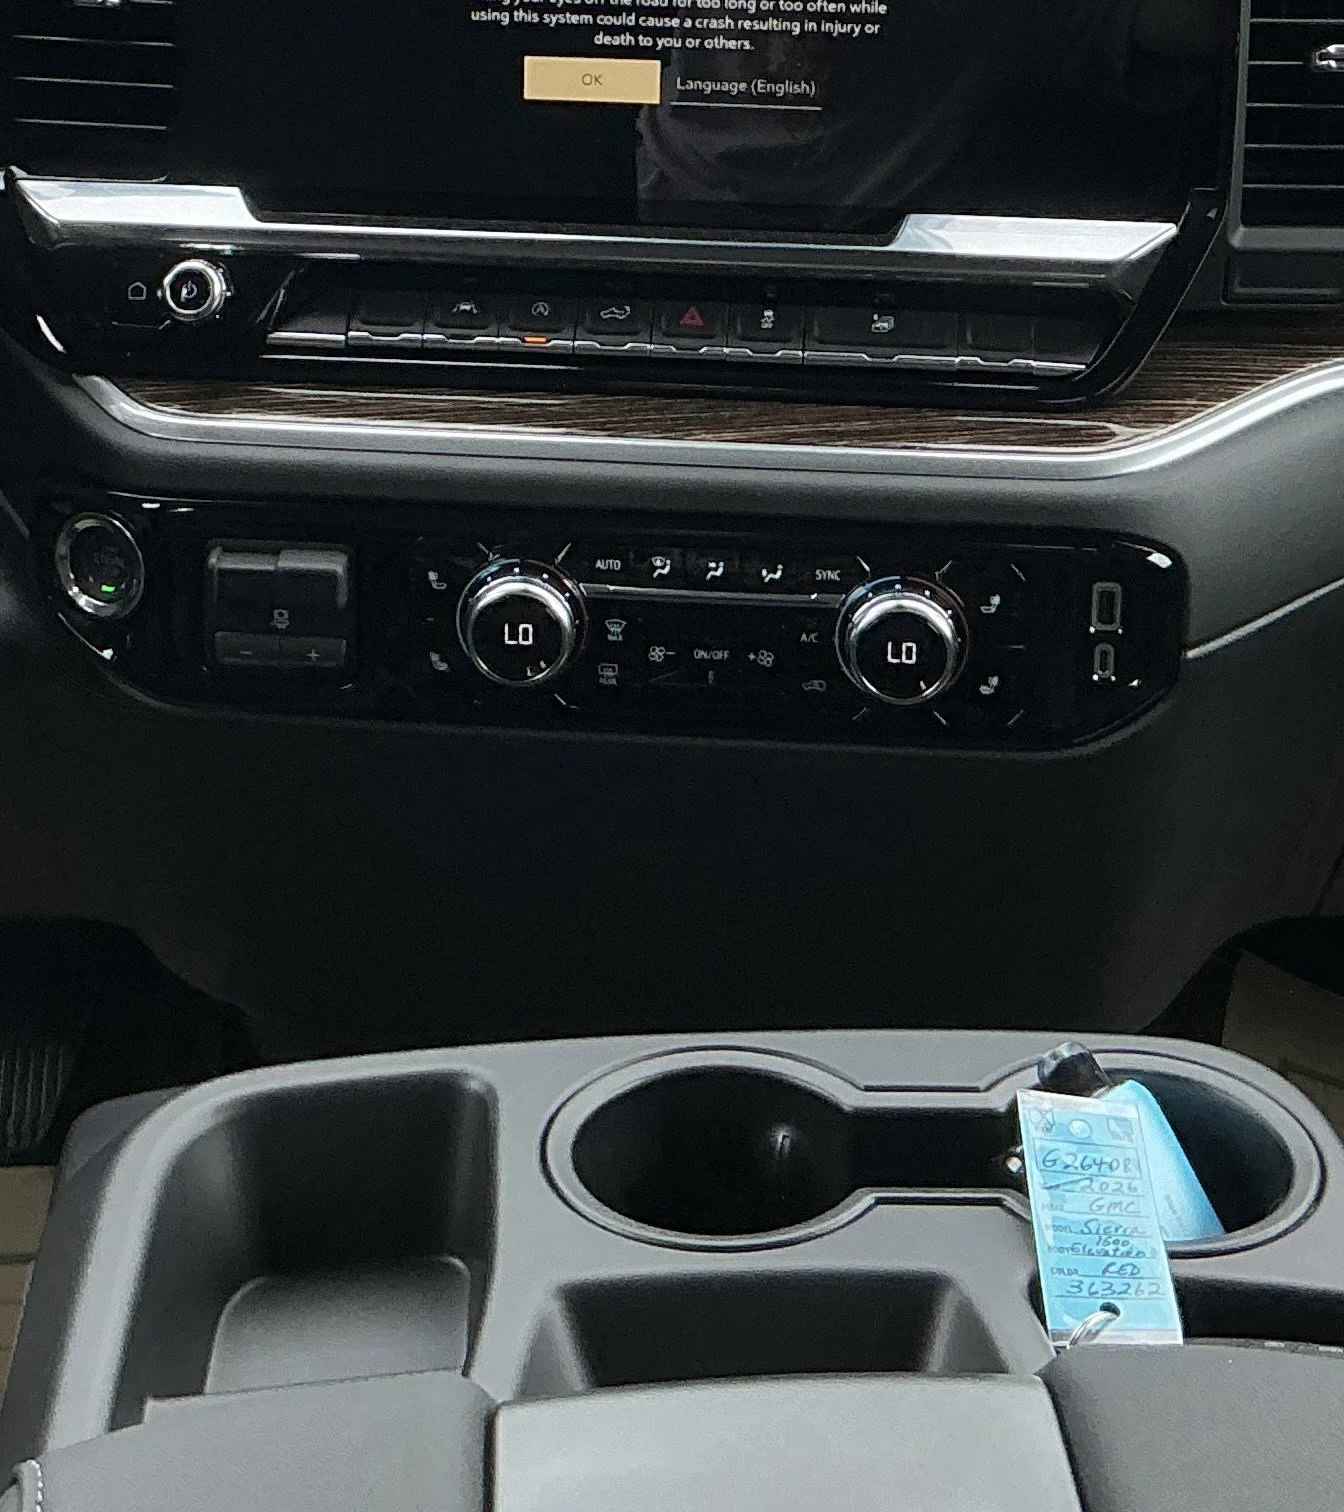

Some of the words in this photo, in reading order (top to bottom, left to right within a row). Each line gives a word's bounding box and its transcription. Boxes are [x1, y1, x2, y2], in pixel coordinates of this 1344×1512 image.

[759, 0, 776, 11] or
[849, 0, 887, 15] while
[471, 8, 510, 25] using
[513, 9, 539, 23] this
[542, 11, 593, 27] system
[596, 12, 636, 26] could
[638, 16, 680, 28] cause
[683, 17, 693, 29] a
[695, 15, 735, 30] crash
[738, 17, 801, 35] resulting
[804, 19, 818, 33] in
[821, 19, 862, 37] injury
[864, 23, 881, 34] or
[594, 31, 635, 47] death
[638, 33, 653, 47] to
[656, 37, 682, 50] you
[685, 37, 701, 49] or
[705, 35, 756, 50] others.
[581, 72, 603, 87] OK
[676, 76, 748, 96] Language
[751, 78, 816, 98] (English)
[595, 559, 621, 571] AUTO
[815, 569, 841, 581] SYNC
[800, 633, 819, 643] A/C
[693, 649, 730, 660] ON/OFF
[1089, 1197, 1141, 1215] GMC
[1080, 1218, 1146, 1236] Sierra
